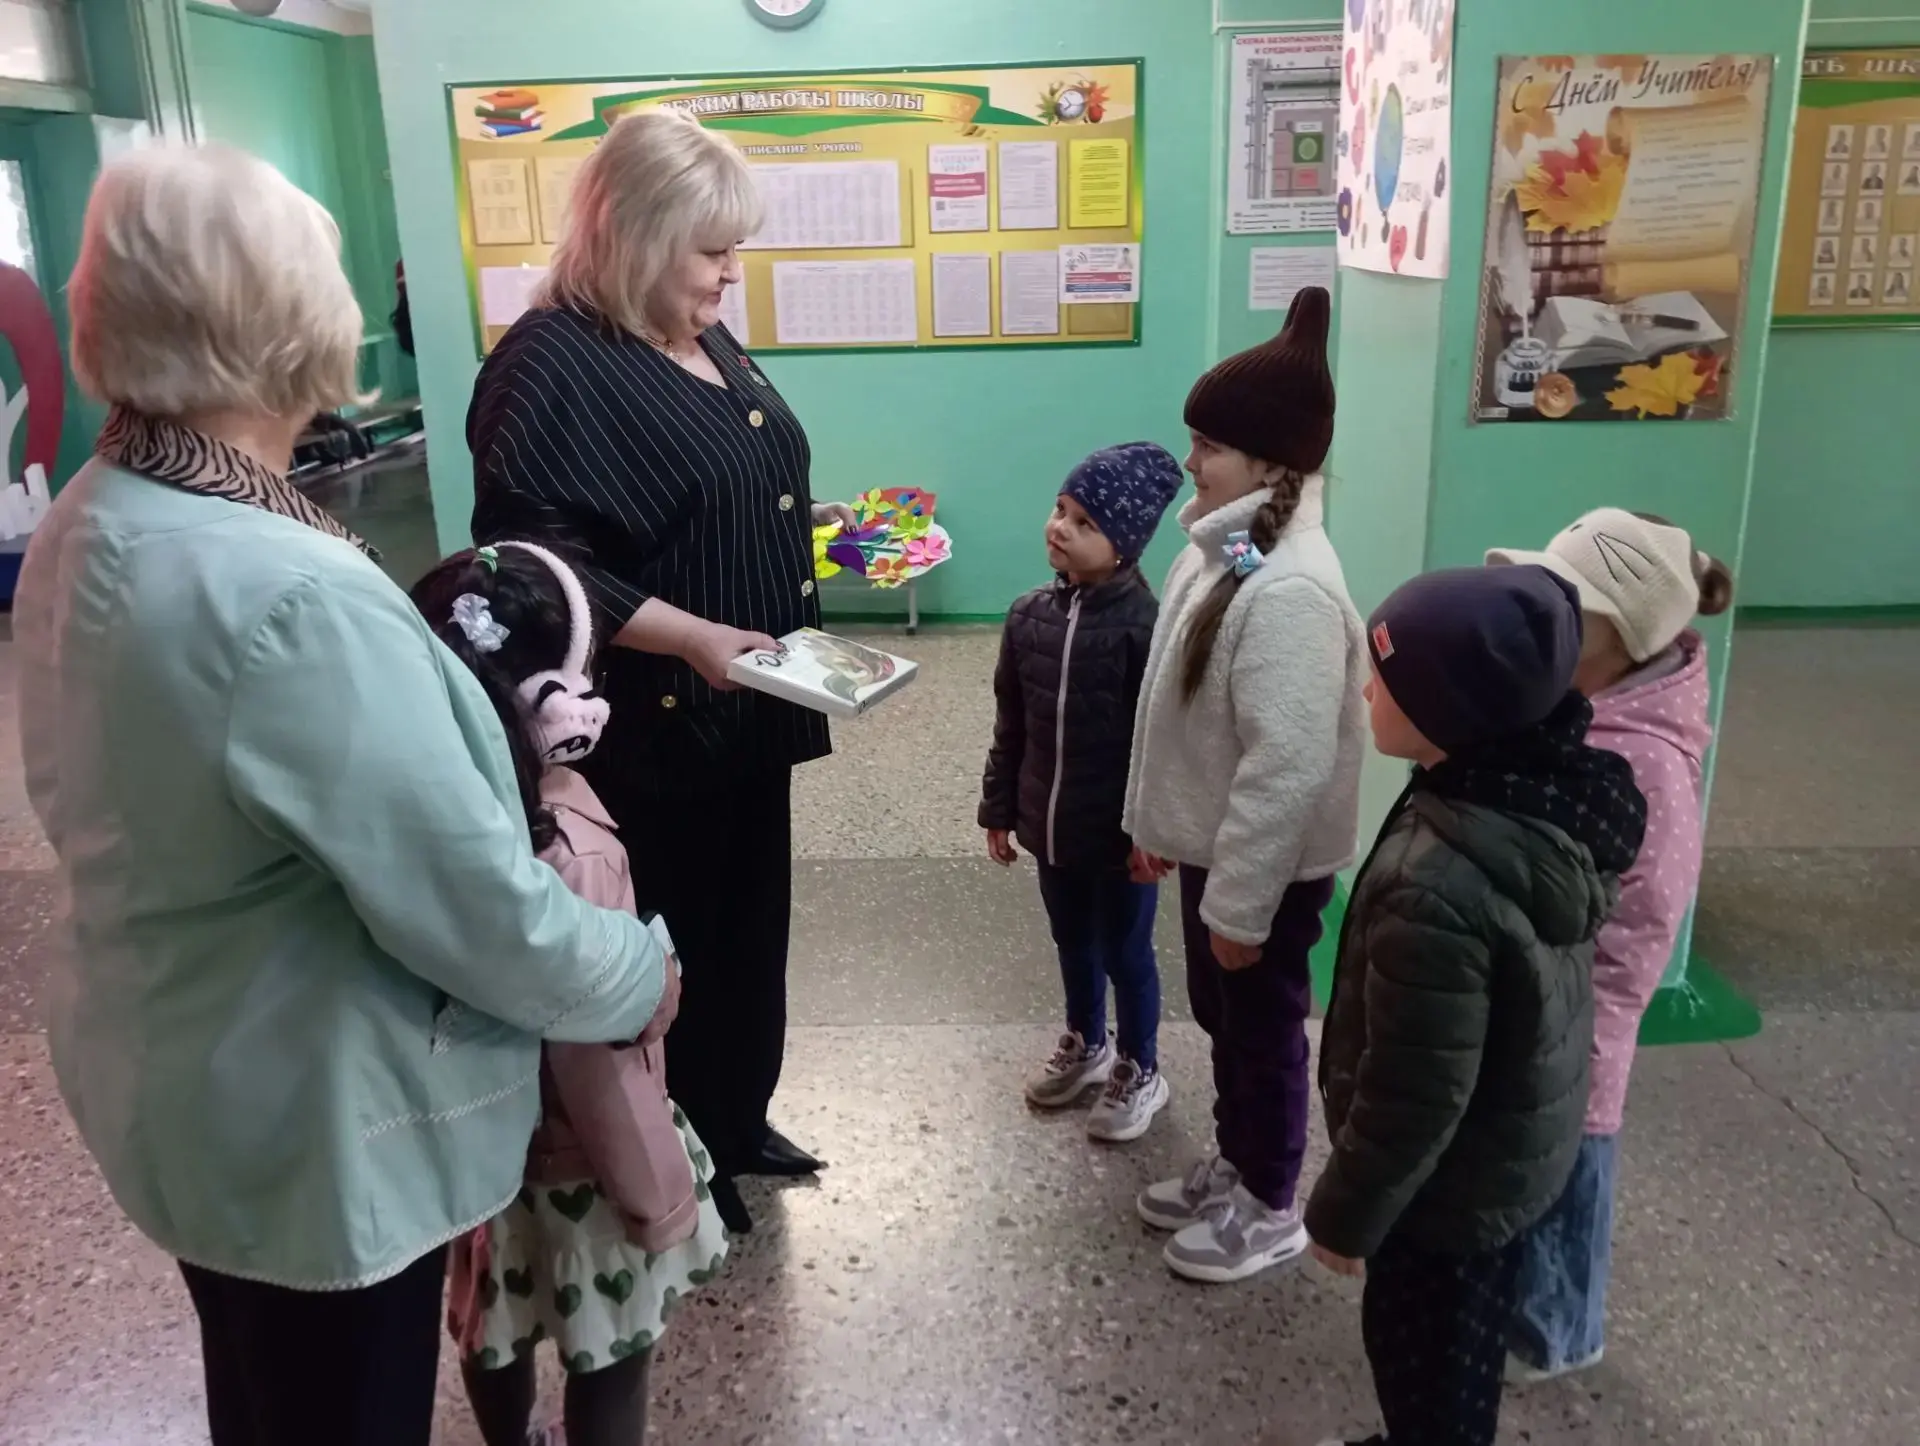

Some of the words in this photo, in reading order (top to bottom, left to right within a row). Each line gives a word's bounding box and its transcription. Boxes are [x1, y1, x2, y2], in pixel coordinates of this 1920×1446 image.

[1512, 75, 1534, 113] С
[1545, 71, 1621, 115] Днём
[1632, 59, 1760, 99] Учителя!
[742, 91, 831, 111] РАБОТЫ
[836, 91, 924, 111] ШКОЛЫ
[813, 142, 863, 154] УРОКОВ
